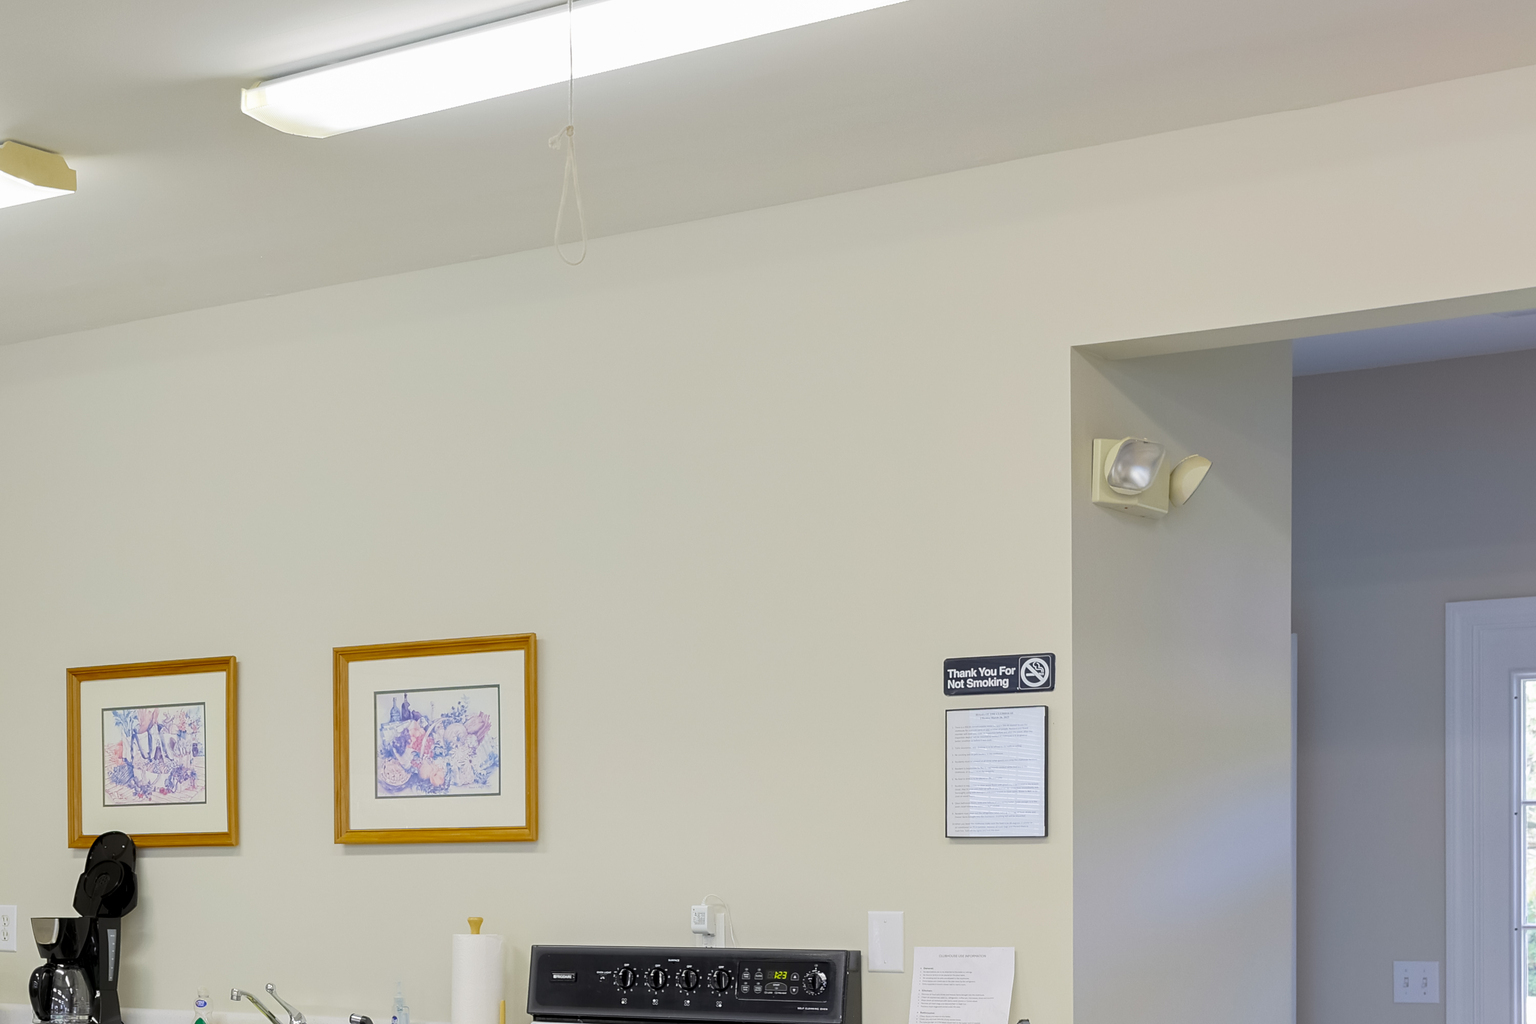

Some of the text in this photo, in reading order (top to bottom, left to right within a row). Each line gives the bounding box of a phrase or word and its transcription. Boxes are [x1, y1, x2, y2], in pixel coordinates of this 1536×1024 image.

[947, 666, 1016, 678] Thank You For
[947, 677, 1009, 689] Not Smoking
